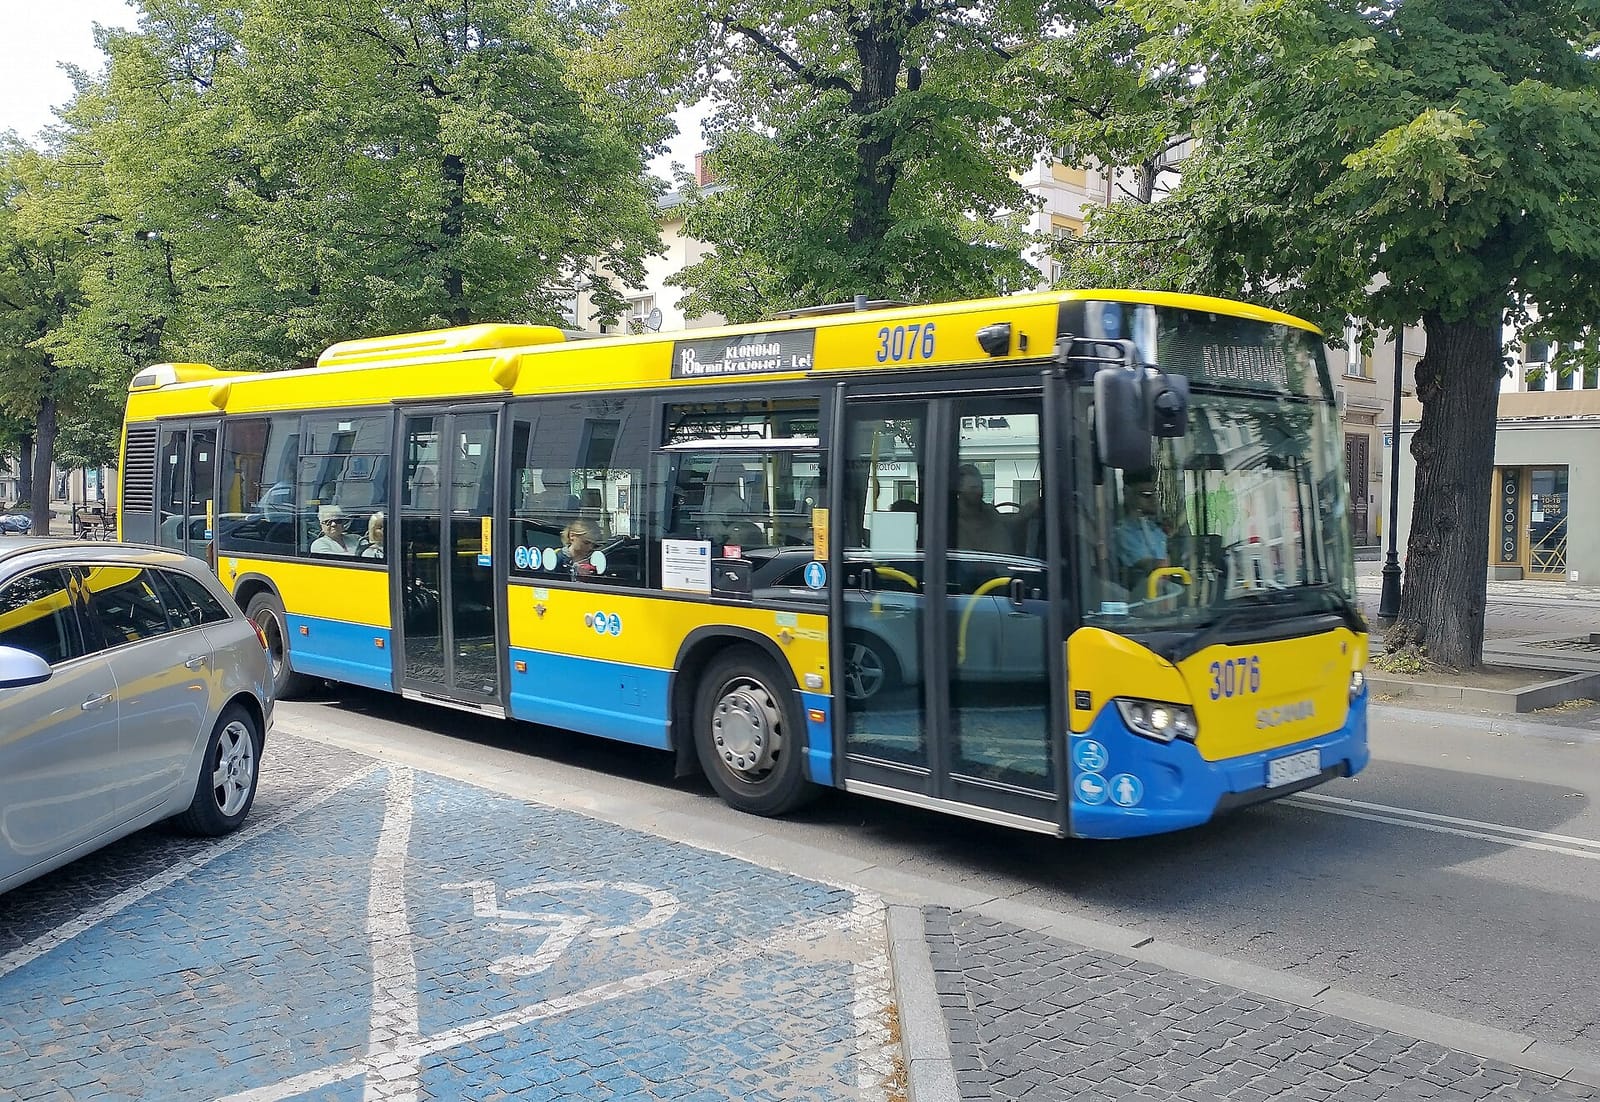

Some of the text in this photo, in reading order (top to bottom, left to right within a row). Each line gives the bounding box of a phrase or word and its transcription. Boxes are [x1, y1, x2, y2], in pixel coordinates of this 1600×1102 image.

[725, 342, 781, 359] KLONOWA
[877, 322, 935, 363] 3076
[723, 356, 781, 372] Krajowej
[1202, 345, 1288, 385] KLONOWA
[1210, 655, 1260, 701] 3076
